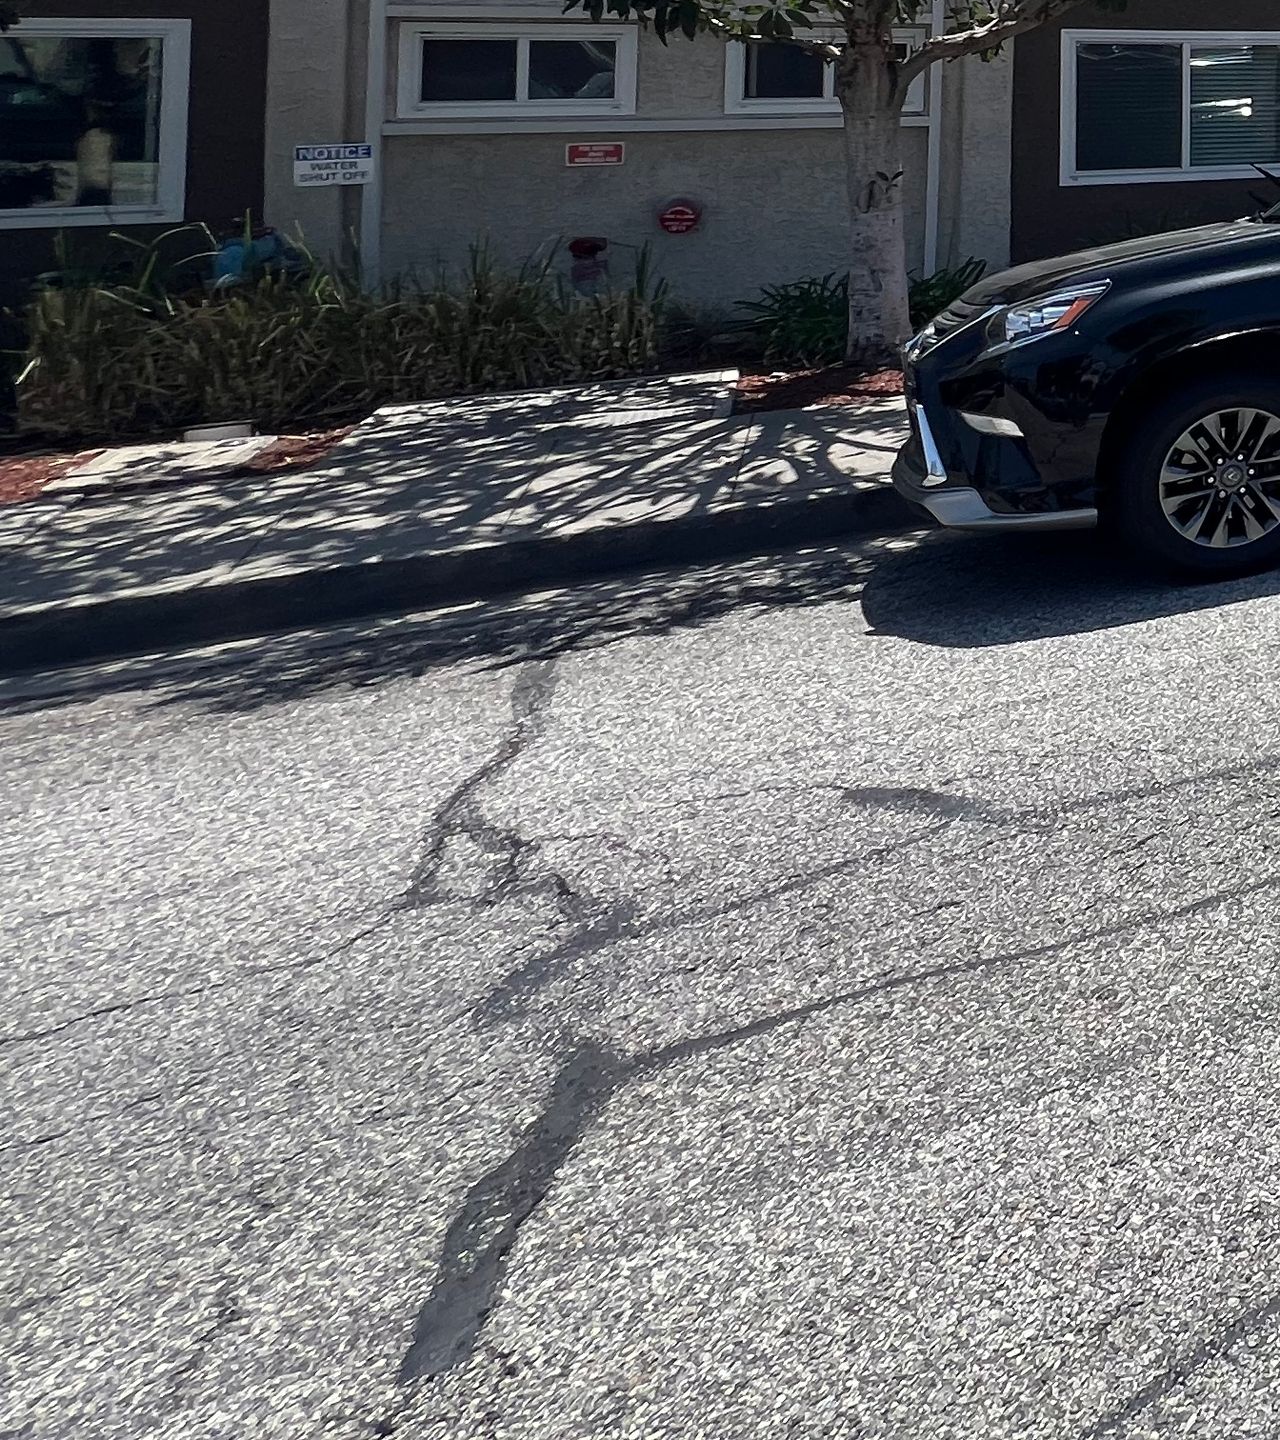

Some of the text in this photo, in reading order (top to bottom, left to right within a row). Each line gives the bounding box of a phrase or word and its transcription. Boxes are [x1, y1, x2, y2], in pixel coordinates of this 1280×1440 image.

[299, 146, 369, 159] NOTICE
[310, 161, 358, 170] WATER
[299, 171, 368, 182] SHUT OFF
